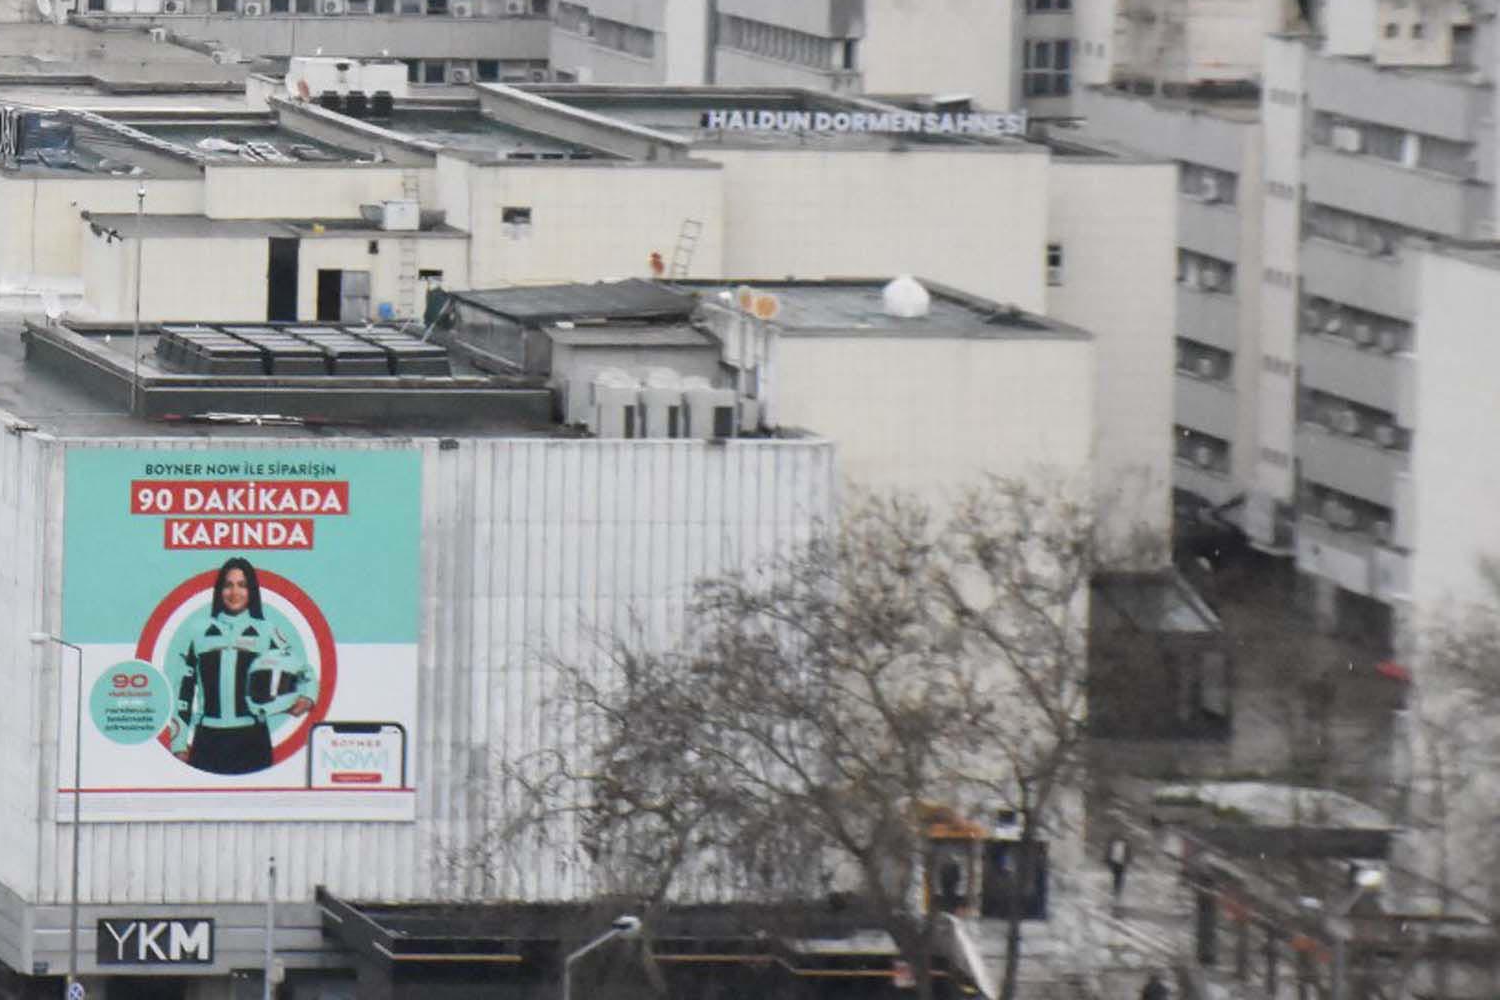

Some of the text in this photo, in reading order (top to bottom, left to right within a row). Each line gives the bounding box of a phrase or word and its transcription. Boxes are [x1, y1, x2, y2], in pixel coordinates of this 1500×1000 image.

[707, 109, 810, 131] HALDUN
[815, 110, 923, 134] DORMEN
[145, 461, 337, 479] BOYNER NOW İLE SİPARİŞİN
[137, 482, 342, 512] 90 DAKİKADA
[171, 522, 309, 546] KAPINDA
[112, 673, 149, 689] 90
[104, 921, 210, 961] YKM
